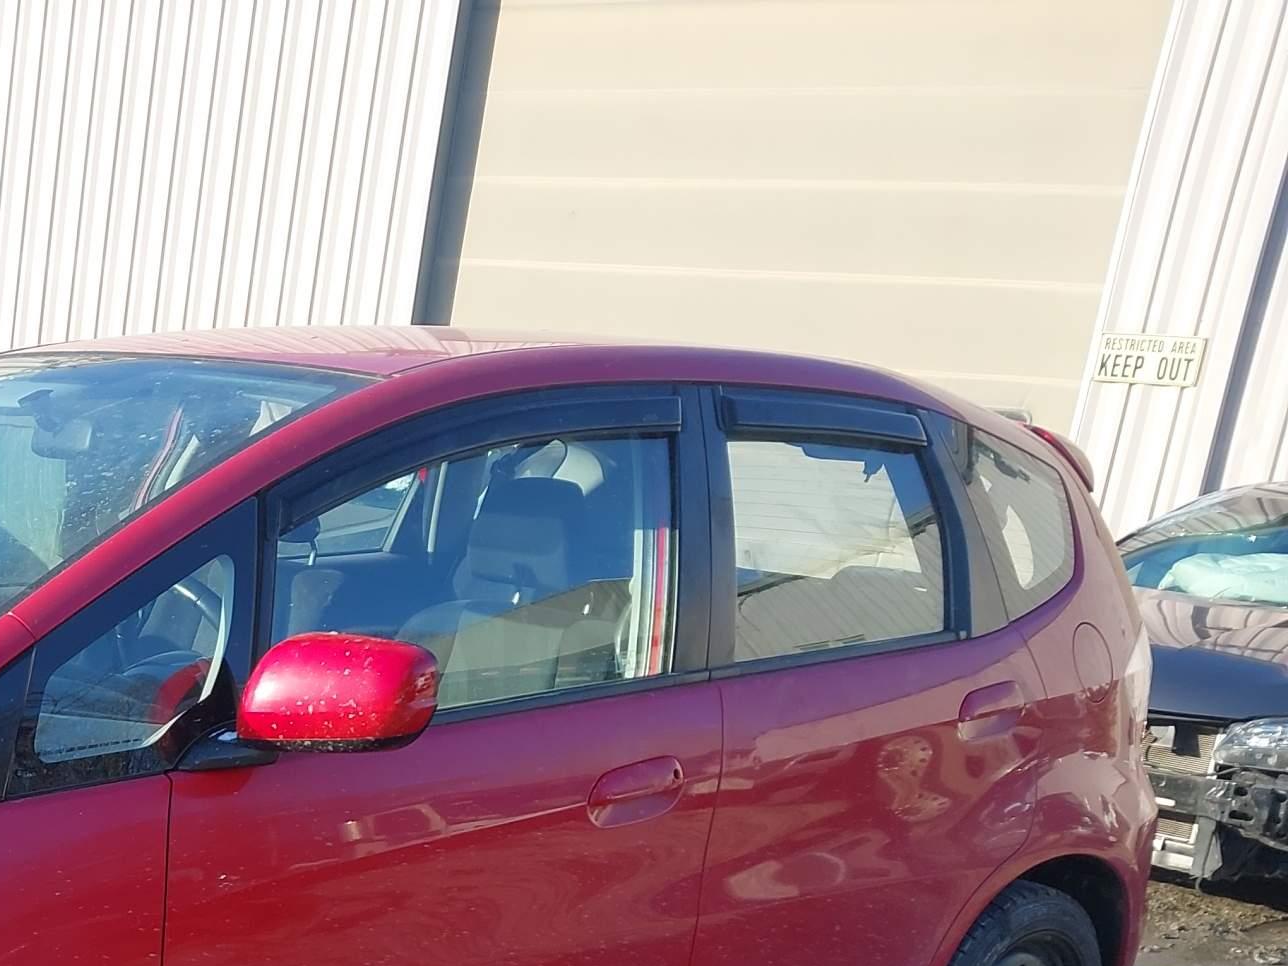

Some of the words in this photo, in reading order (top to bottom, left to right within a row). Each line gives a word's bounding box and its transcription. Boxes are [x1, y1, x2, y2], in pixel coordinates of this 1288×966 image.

[1104, 337, 1165, 353] RESTRICTED
[1171, 340, 1197, 355] AREA
[1098, 353, 1145, 378] KEEP
[1156, 356, 1195, 382] OUT
